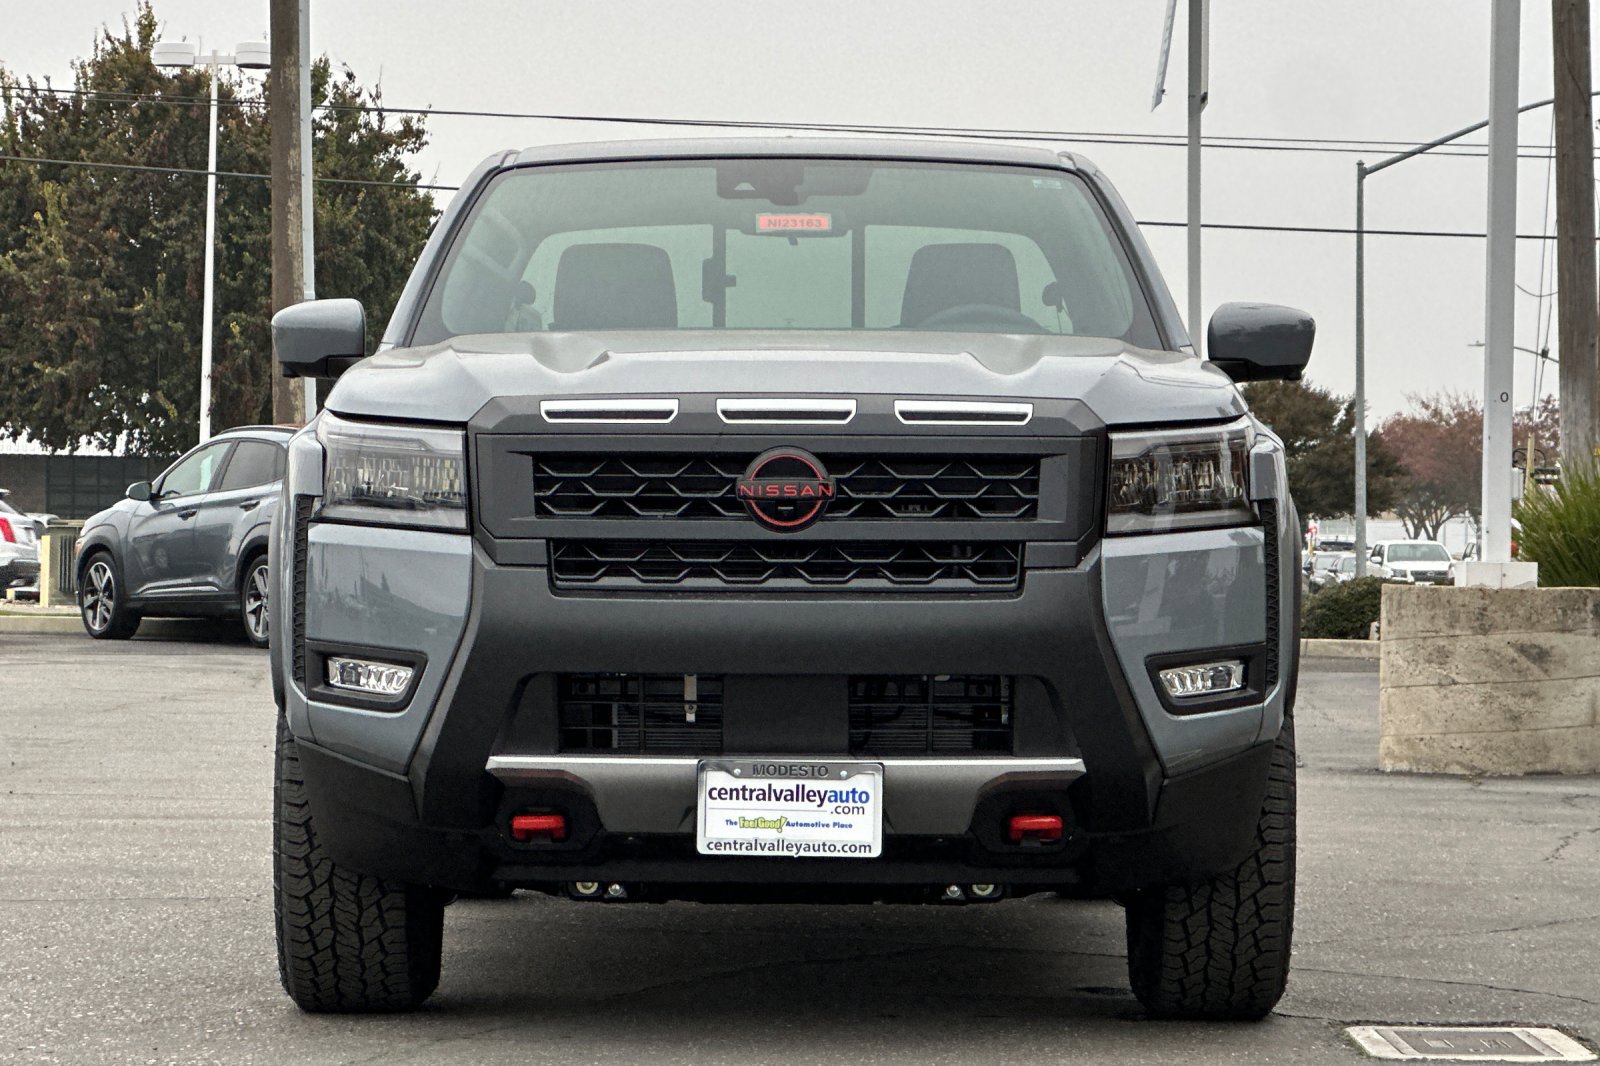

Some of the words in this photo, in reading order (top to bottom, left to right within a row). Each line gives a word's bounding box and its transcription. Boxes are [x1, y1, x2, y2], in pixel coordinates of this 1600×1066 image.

[767, 218, 822, 228] NI23163
[739, 484, 833, 497] NISSAN
[752, 763, 829, 778] MODESTO
[708, 783, 870, 807] centralvalleyauto
[830, 805, 865, 815] .com
[786, 820, 830, 829] Automotive
[832, 821, 853, 829] Place
[706, 838, 872, 855] centralvalleyauto.com
